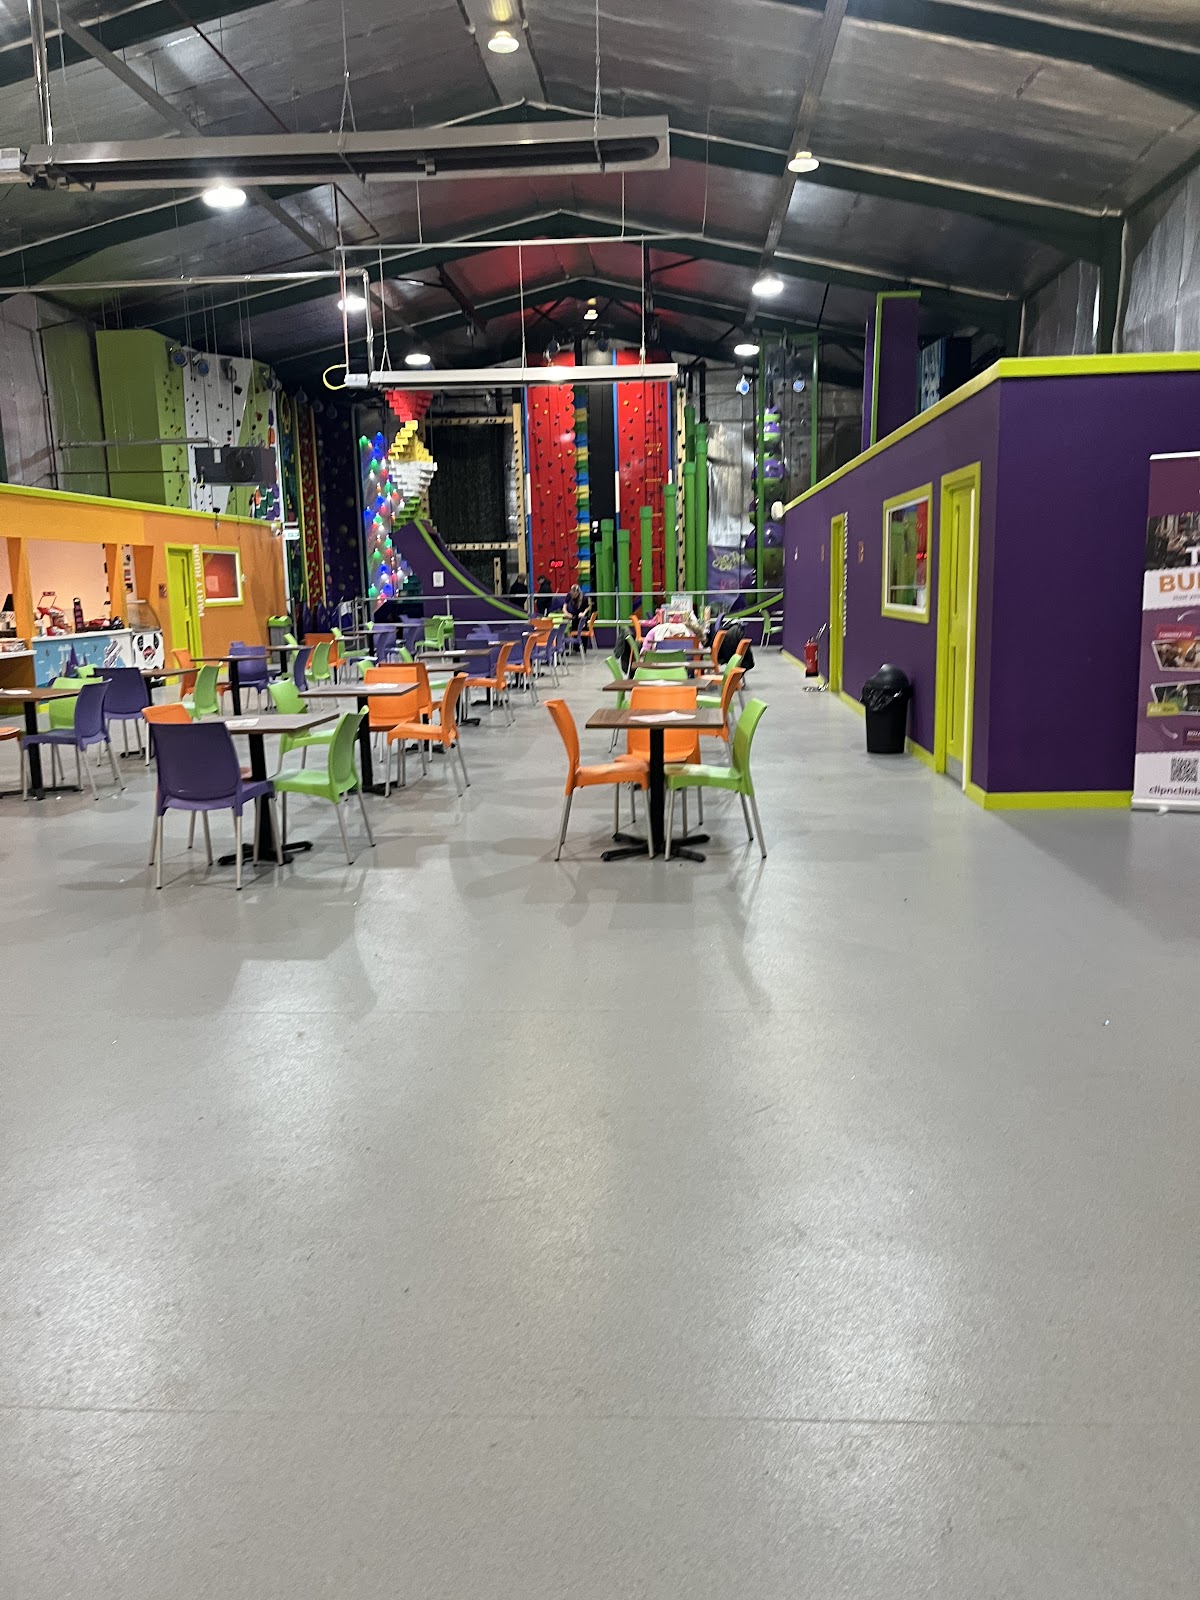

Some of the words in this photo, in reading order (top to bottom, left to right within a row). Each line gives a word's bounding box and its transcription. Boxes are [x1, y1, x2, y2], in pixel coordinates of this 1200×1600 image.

[193, 543, 202, 578] ROOM
[196, 581, 205, 617] PARTY
[1159, 572, 1200, 593] BU
